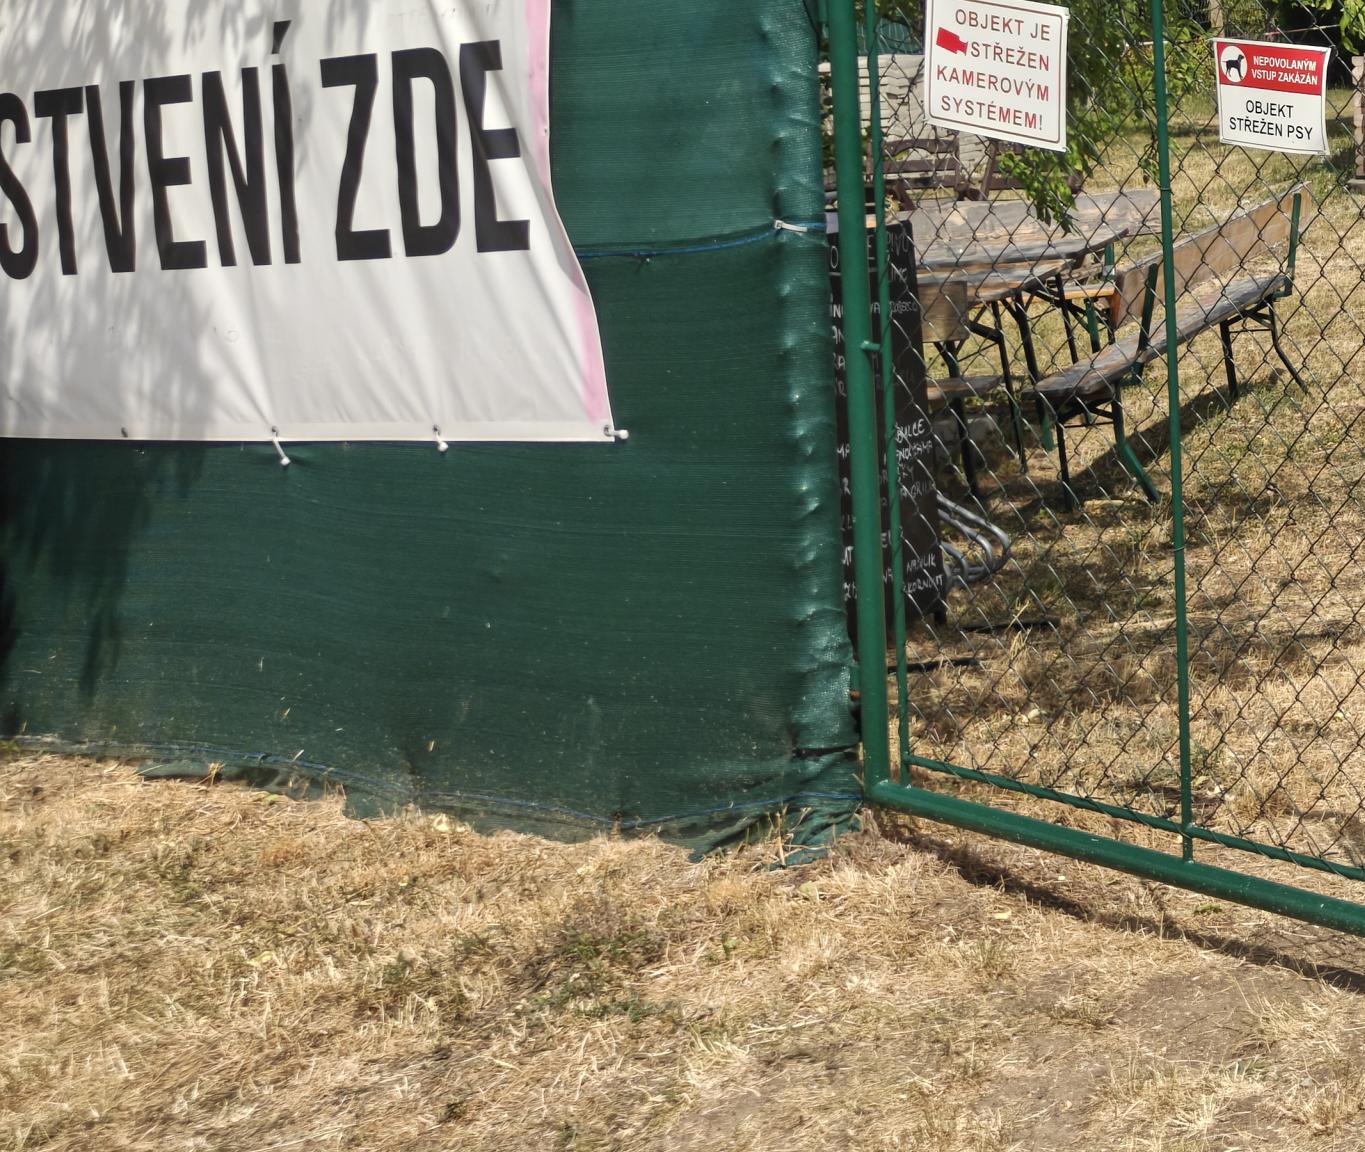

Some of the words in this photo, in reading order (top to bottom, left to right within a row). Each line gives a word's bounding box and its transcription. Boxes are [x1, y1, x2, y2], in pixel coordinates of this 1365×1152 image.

[955, 8, 1025, 37] OBJEKT
[1030, 22, 1051, 41] JE
[970, 41, 1050, 72] STŘEŽEN
[1253, 55, 1317, 72] NEPOVOLANÝM
[936, 64, 1049, 102] KAMEROVÝM
[1251, 68, 1277, 81] VSTUP
[1277, 70, 1318, 86] ZAKÁZÁN
[941, 95, 1043, 131] SYSTÉMEM!
[1245, 99, 1294, 119] OBJEKT
[1229, 116, 1283, 137] STŘEŽEN
[1287, 124, 1313, 141] PSY
[0, 20, 301, 280] STVENÍ
[320, 39, 531, 262] ZDE
